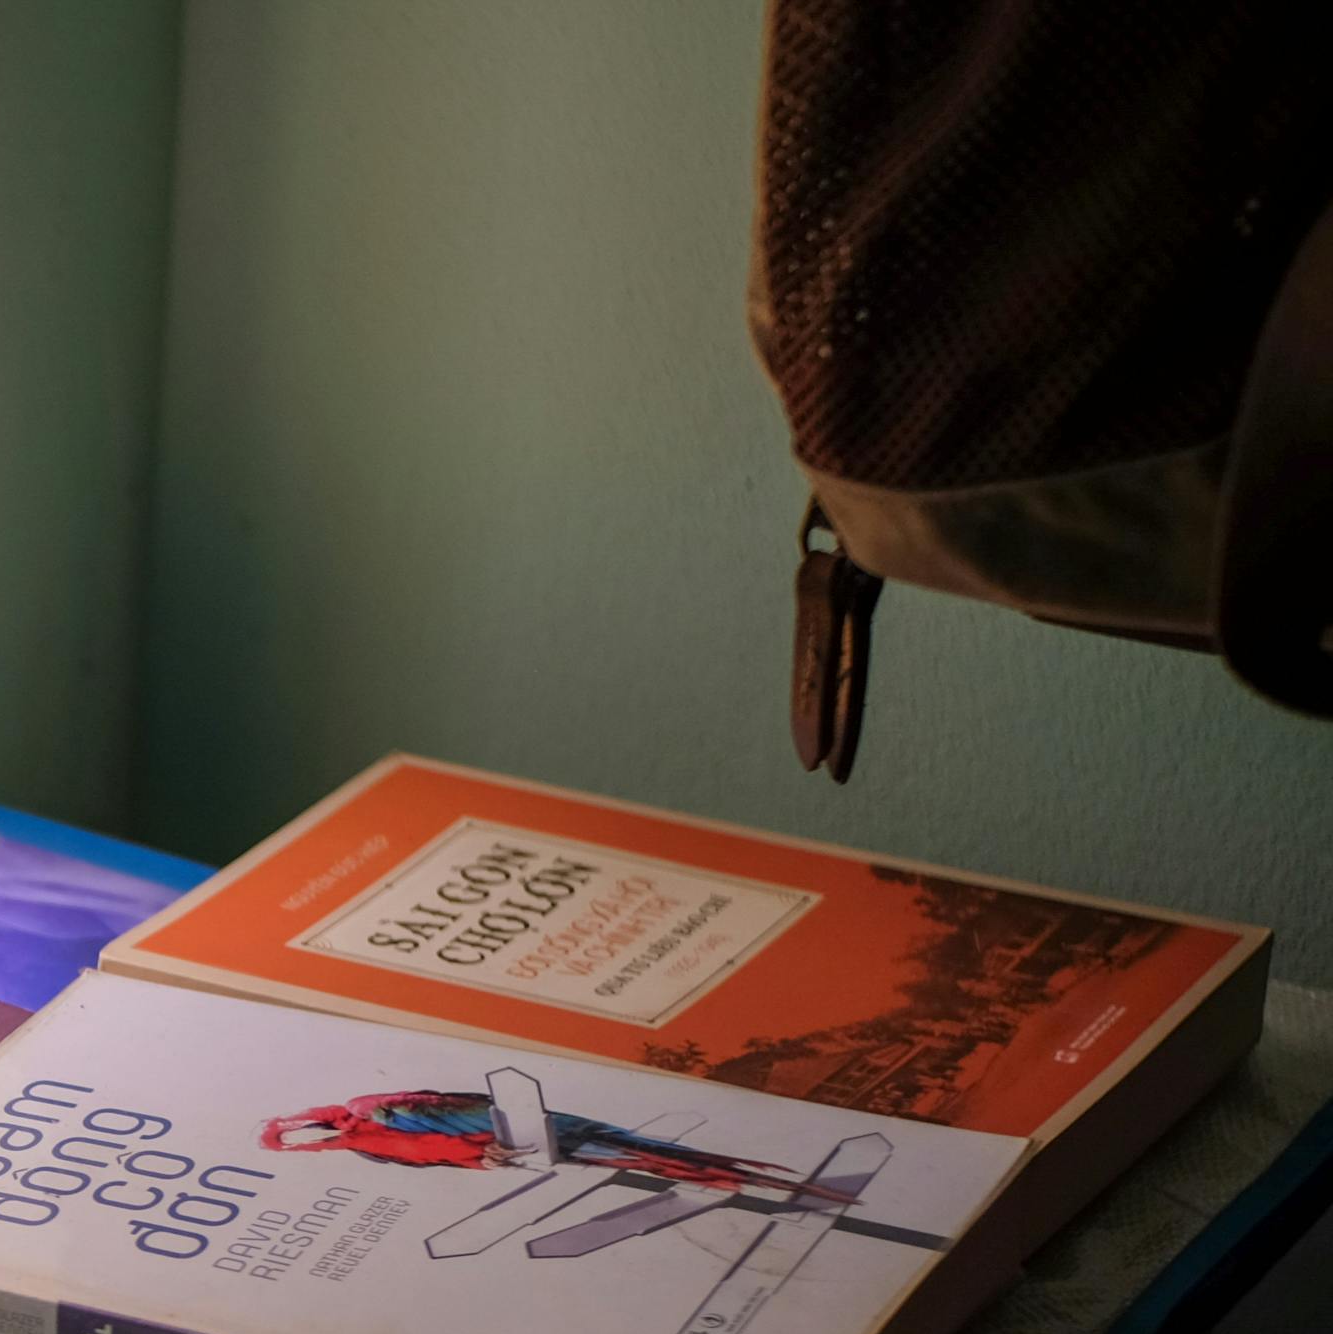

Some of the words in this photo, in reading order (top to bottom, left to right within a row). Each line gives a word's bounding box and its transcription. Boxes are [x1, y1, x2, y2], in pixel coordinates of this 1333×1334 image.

[367, 902, 461, 954] SÀI
[437, 842, 540, 907] GÒN
[437, 911, 537, 968] CHỢ
[511, 855, 603, 918] LỚN
[91, 1148, 195, 1212] cô
[127, 1164, 276, 1260] đơn
[349, 1196, 395, 1233] GLAZER
[212, 1209, 292, 1274] DAVID
[249, 1186, 361, 1281] RIESMAN
